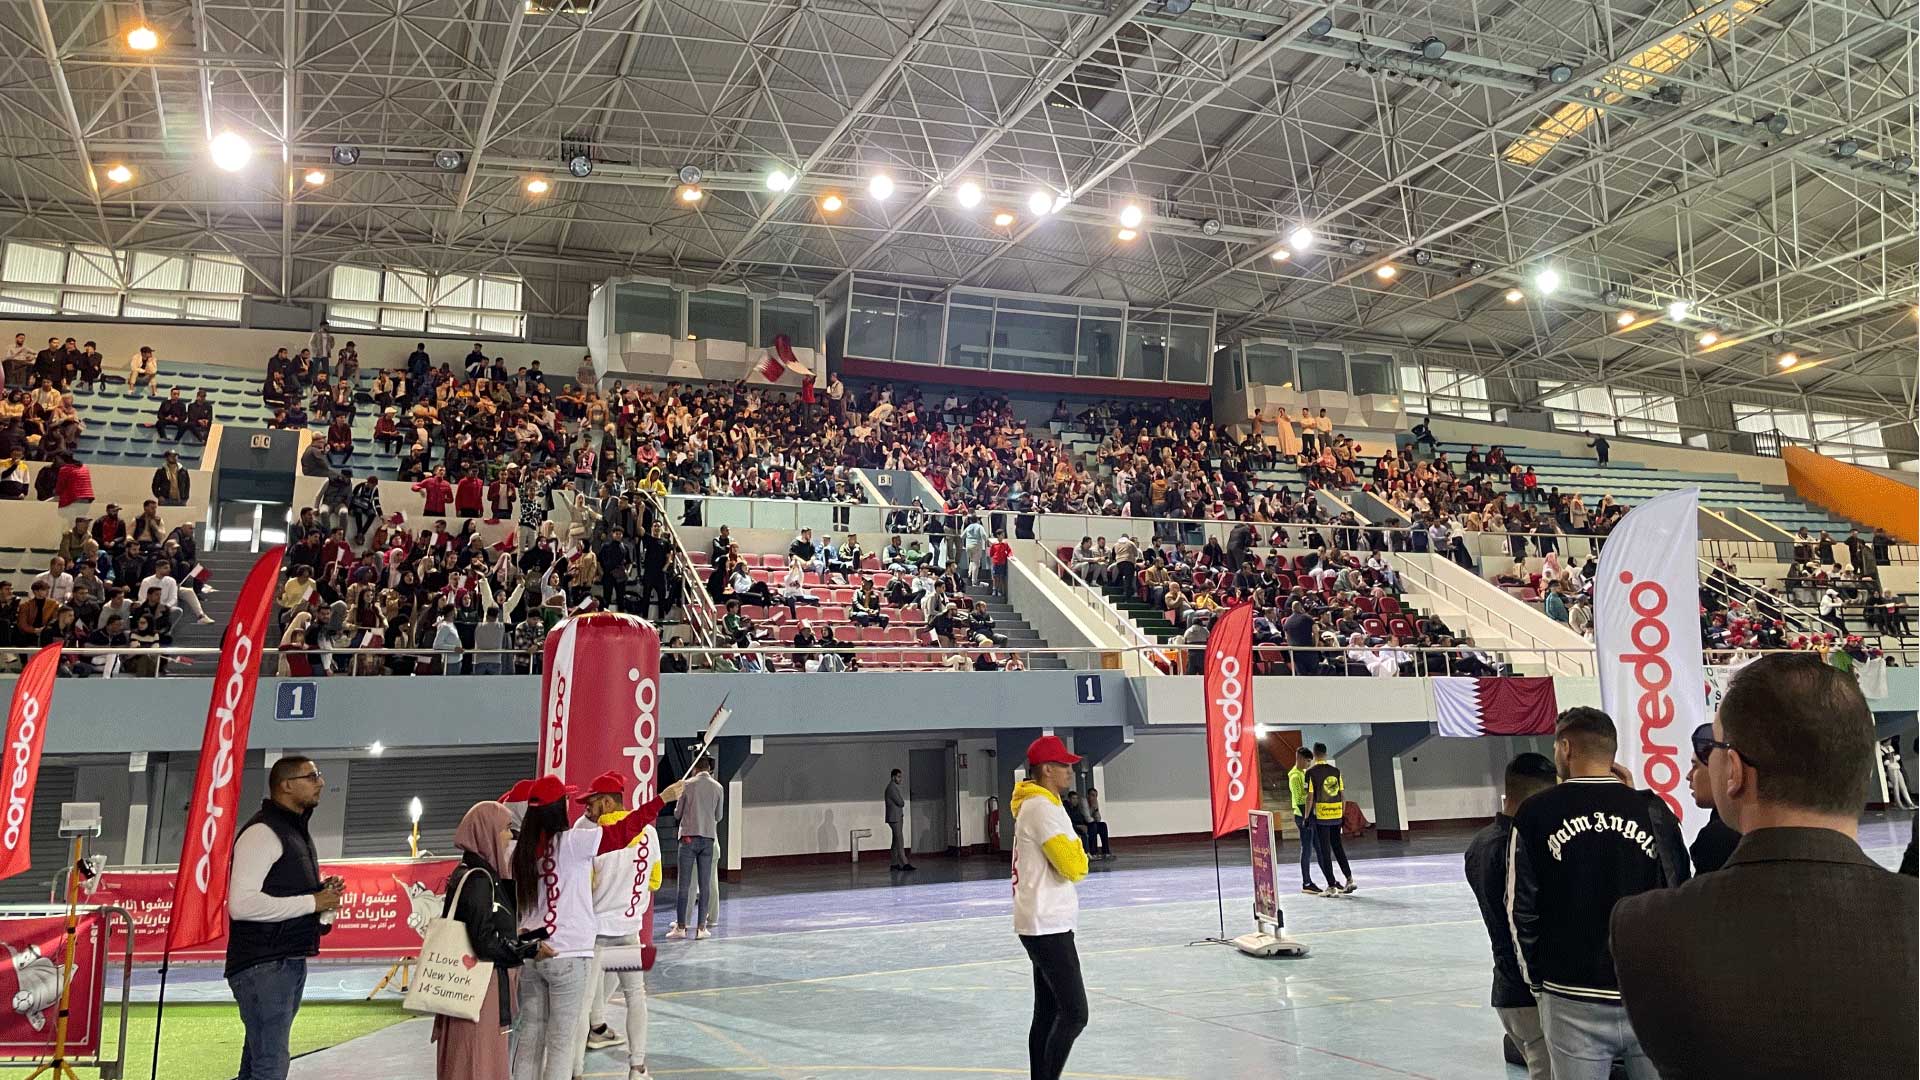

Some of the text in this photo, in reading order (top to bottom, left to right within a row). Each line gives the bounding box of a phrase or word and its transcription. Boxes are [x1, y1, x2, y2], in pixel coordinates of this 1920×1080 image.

[291, 686, 303, 715] 1
[1086, 678, 1095, 701] 1
[623, 668, 656, 811] edoo
[1216, 650, 1244, 802] ooredoo
[4, 692, 39, 850] ooredoo
[195, 621, 252, 893] ooredoo
[1547, 811, 1658, 861] Palm Angels
[423, 968, 473, 986] New York
[436, 953, 460, 967] Love
